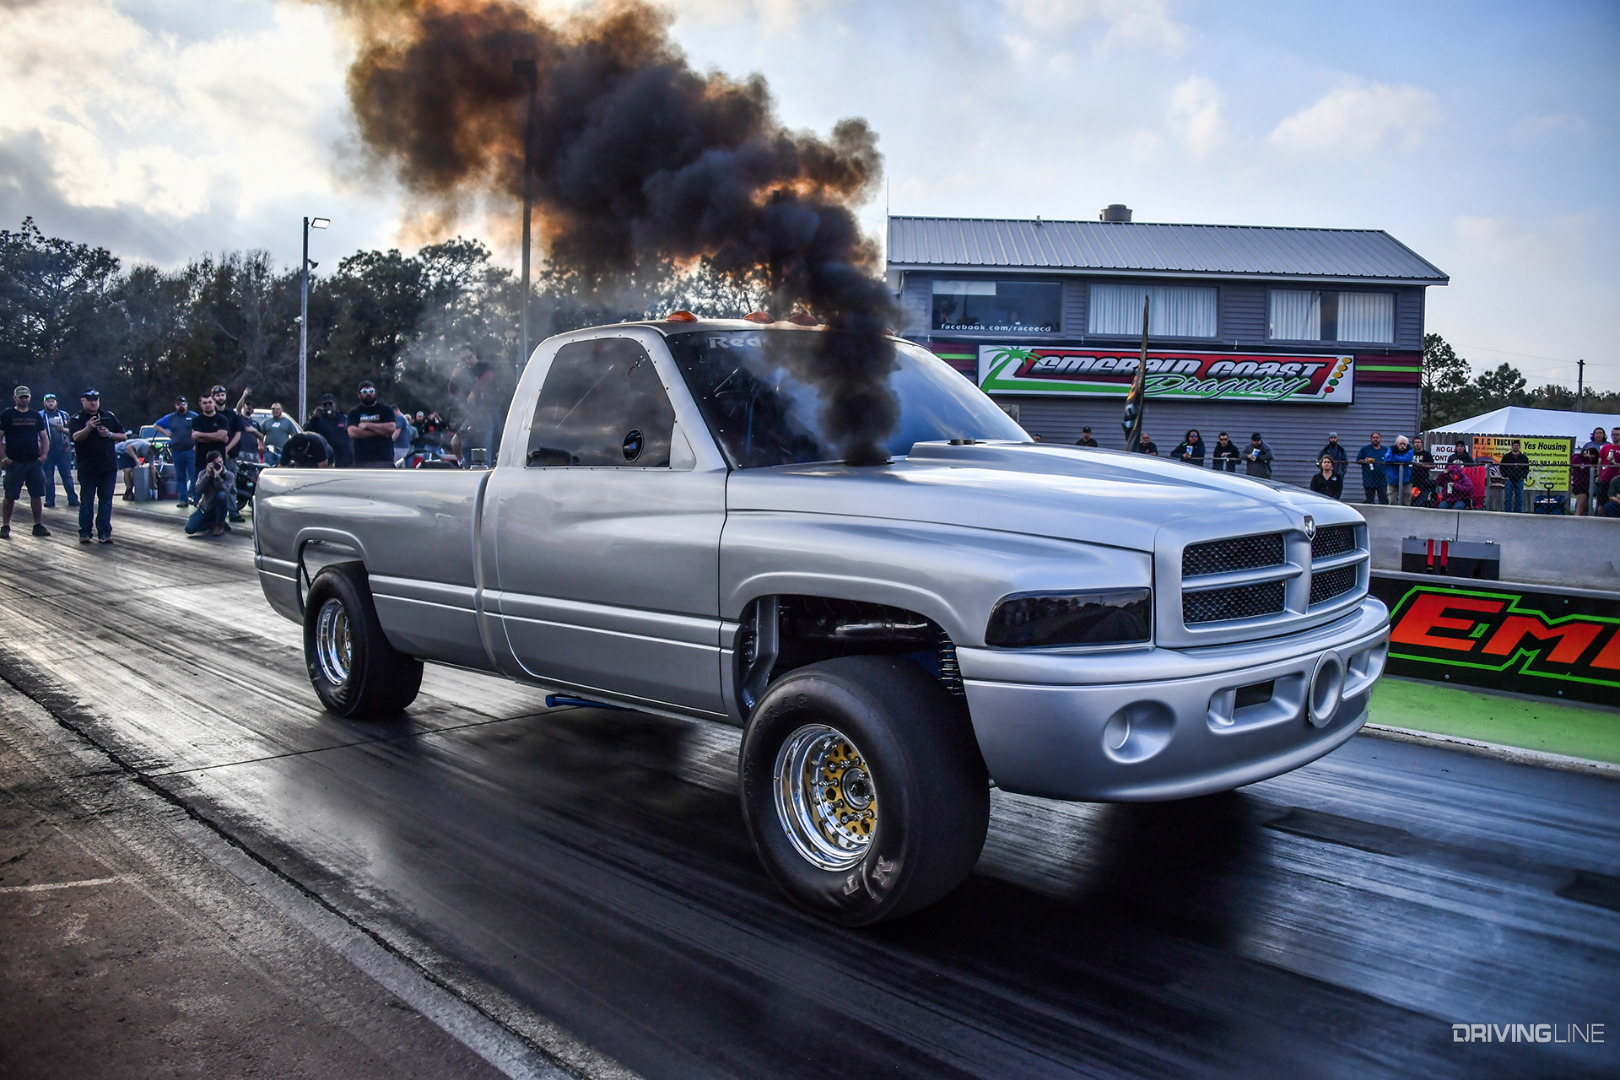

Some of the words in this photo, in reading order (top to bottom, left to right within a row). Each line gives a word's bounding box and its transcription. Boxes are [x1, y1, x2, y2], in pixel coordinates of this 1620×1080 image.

[940, 323, 1052, 332] facebook.com/raceecd
[1206, 359, 1329, 378] COAST
[1144, 374, 1310, 400] Dragway
[1524, 442, 1536, 450] Yes
[1538, 442, 1567, 452] Housing
